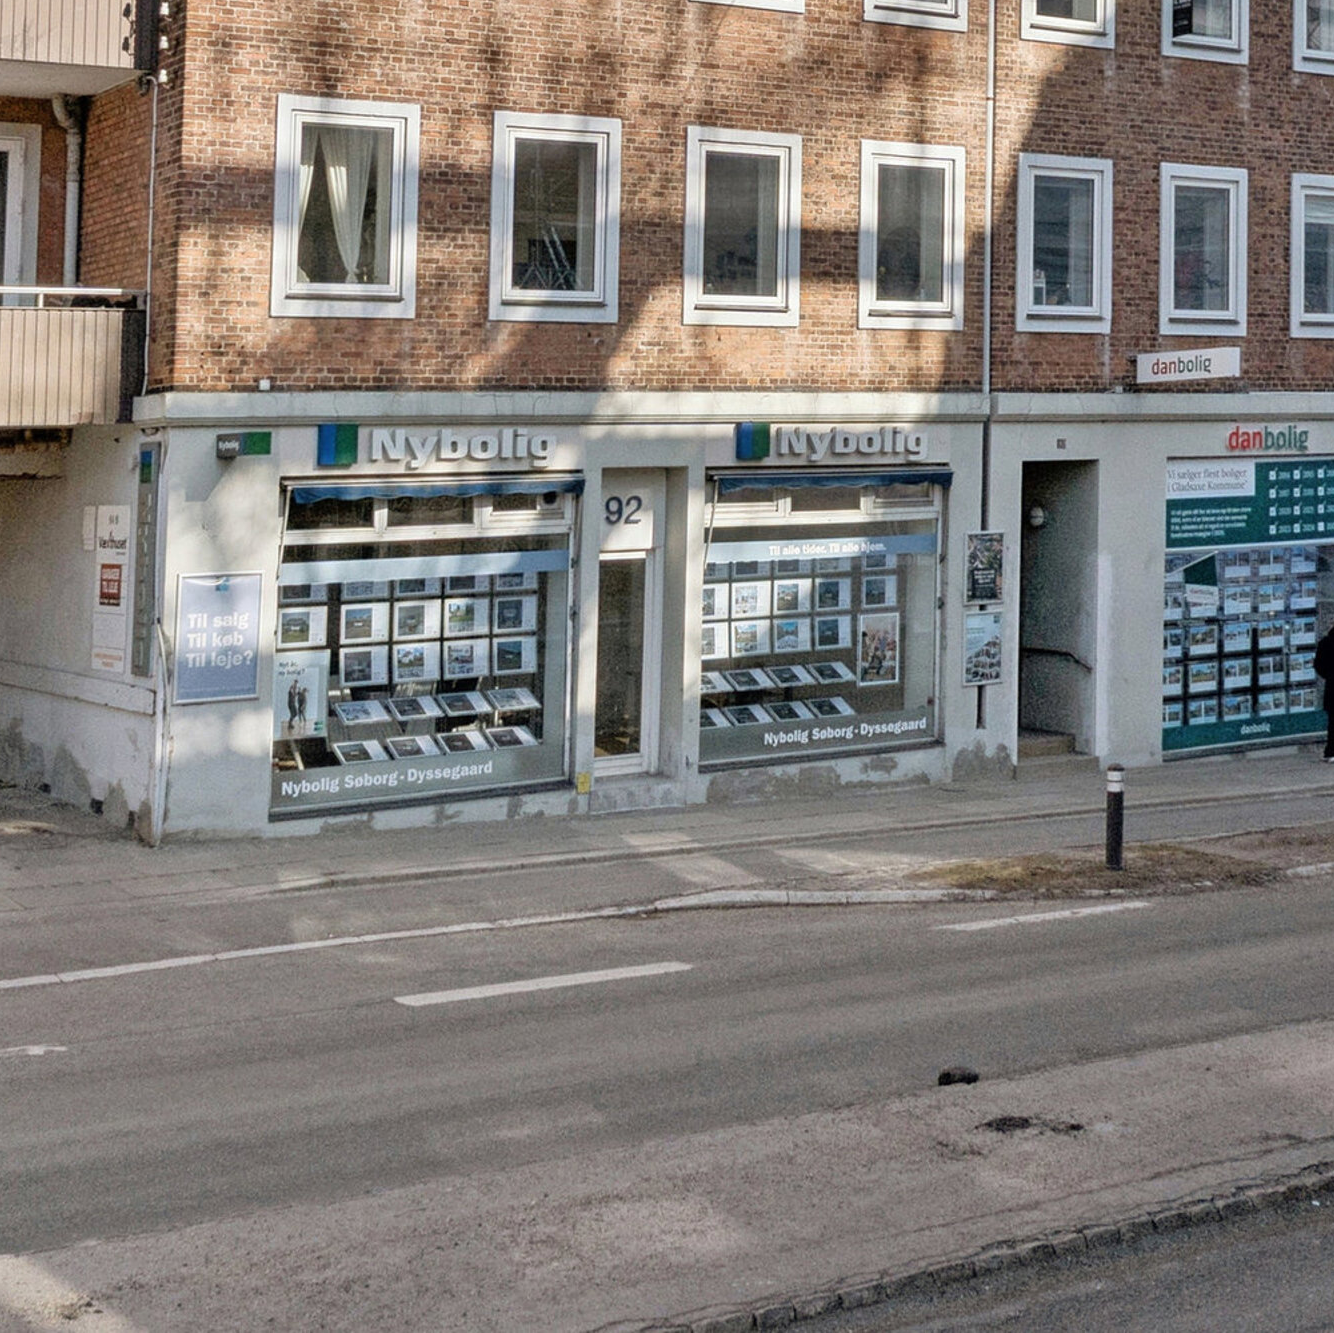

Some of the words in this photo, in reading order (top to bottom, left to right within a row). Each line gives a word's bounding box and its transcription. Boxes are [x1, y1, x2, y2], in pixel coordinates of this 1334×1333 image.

[1152, 354, 1212, 377] danbolig
[370, 428, 558, 469] Nybolig
[779, 426, 930, 462] Nybolig
[1228, 425, 1310, 451] danbolig
[604, 495, 643, 525] 92
[187, 613, 207, 628] Til
[213, 612, 249, 630] salg
[187, 632, 207, 648] Til
[212, 631, 244, 648] køb
[186, 652, 206, 668] Til
[211, 650, 254, 669] leje?
[763, 730, 809, 747] Nybolig
[281, 777, 340, 798] Nybolig
